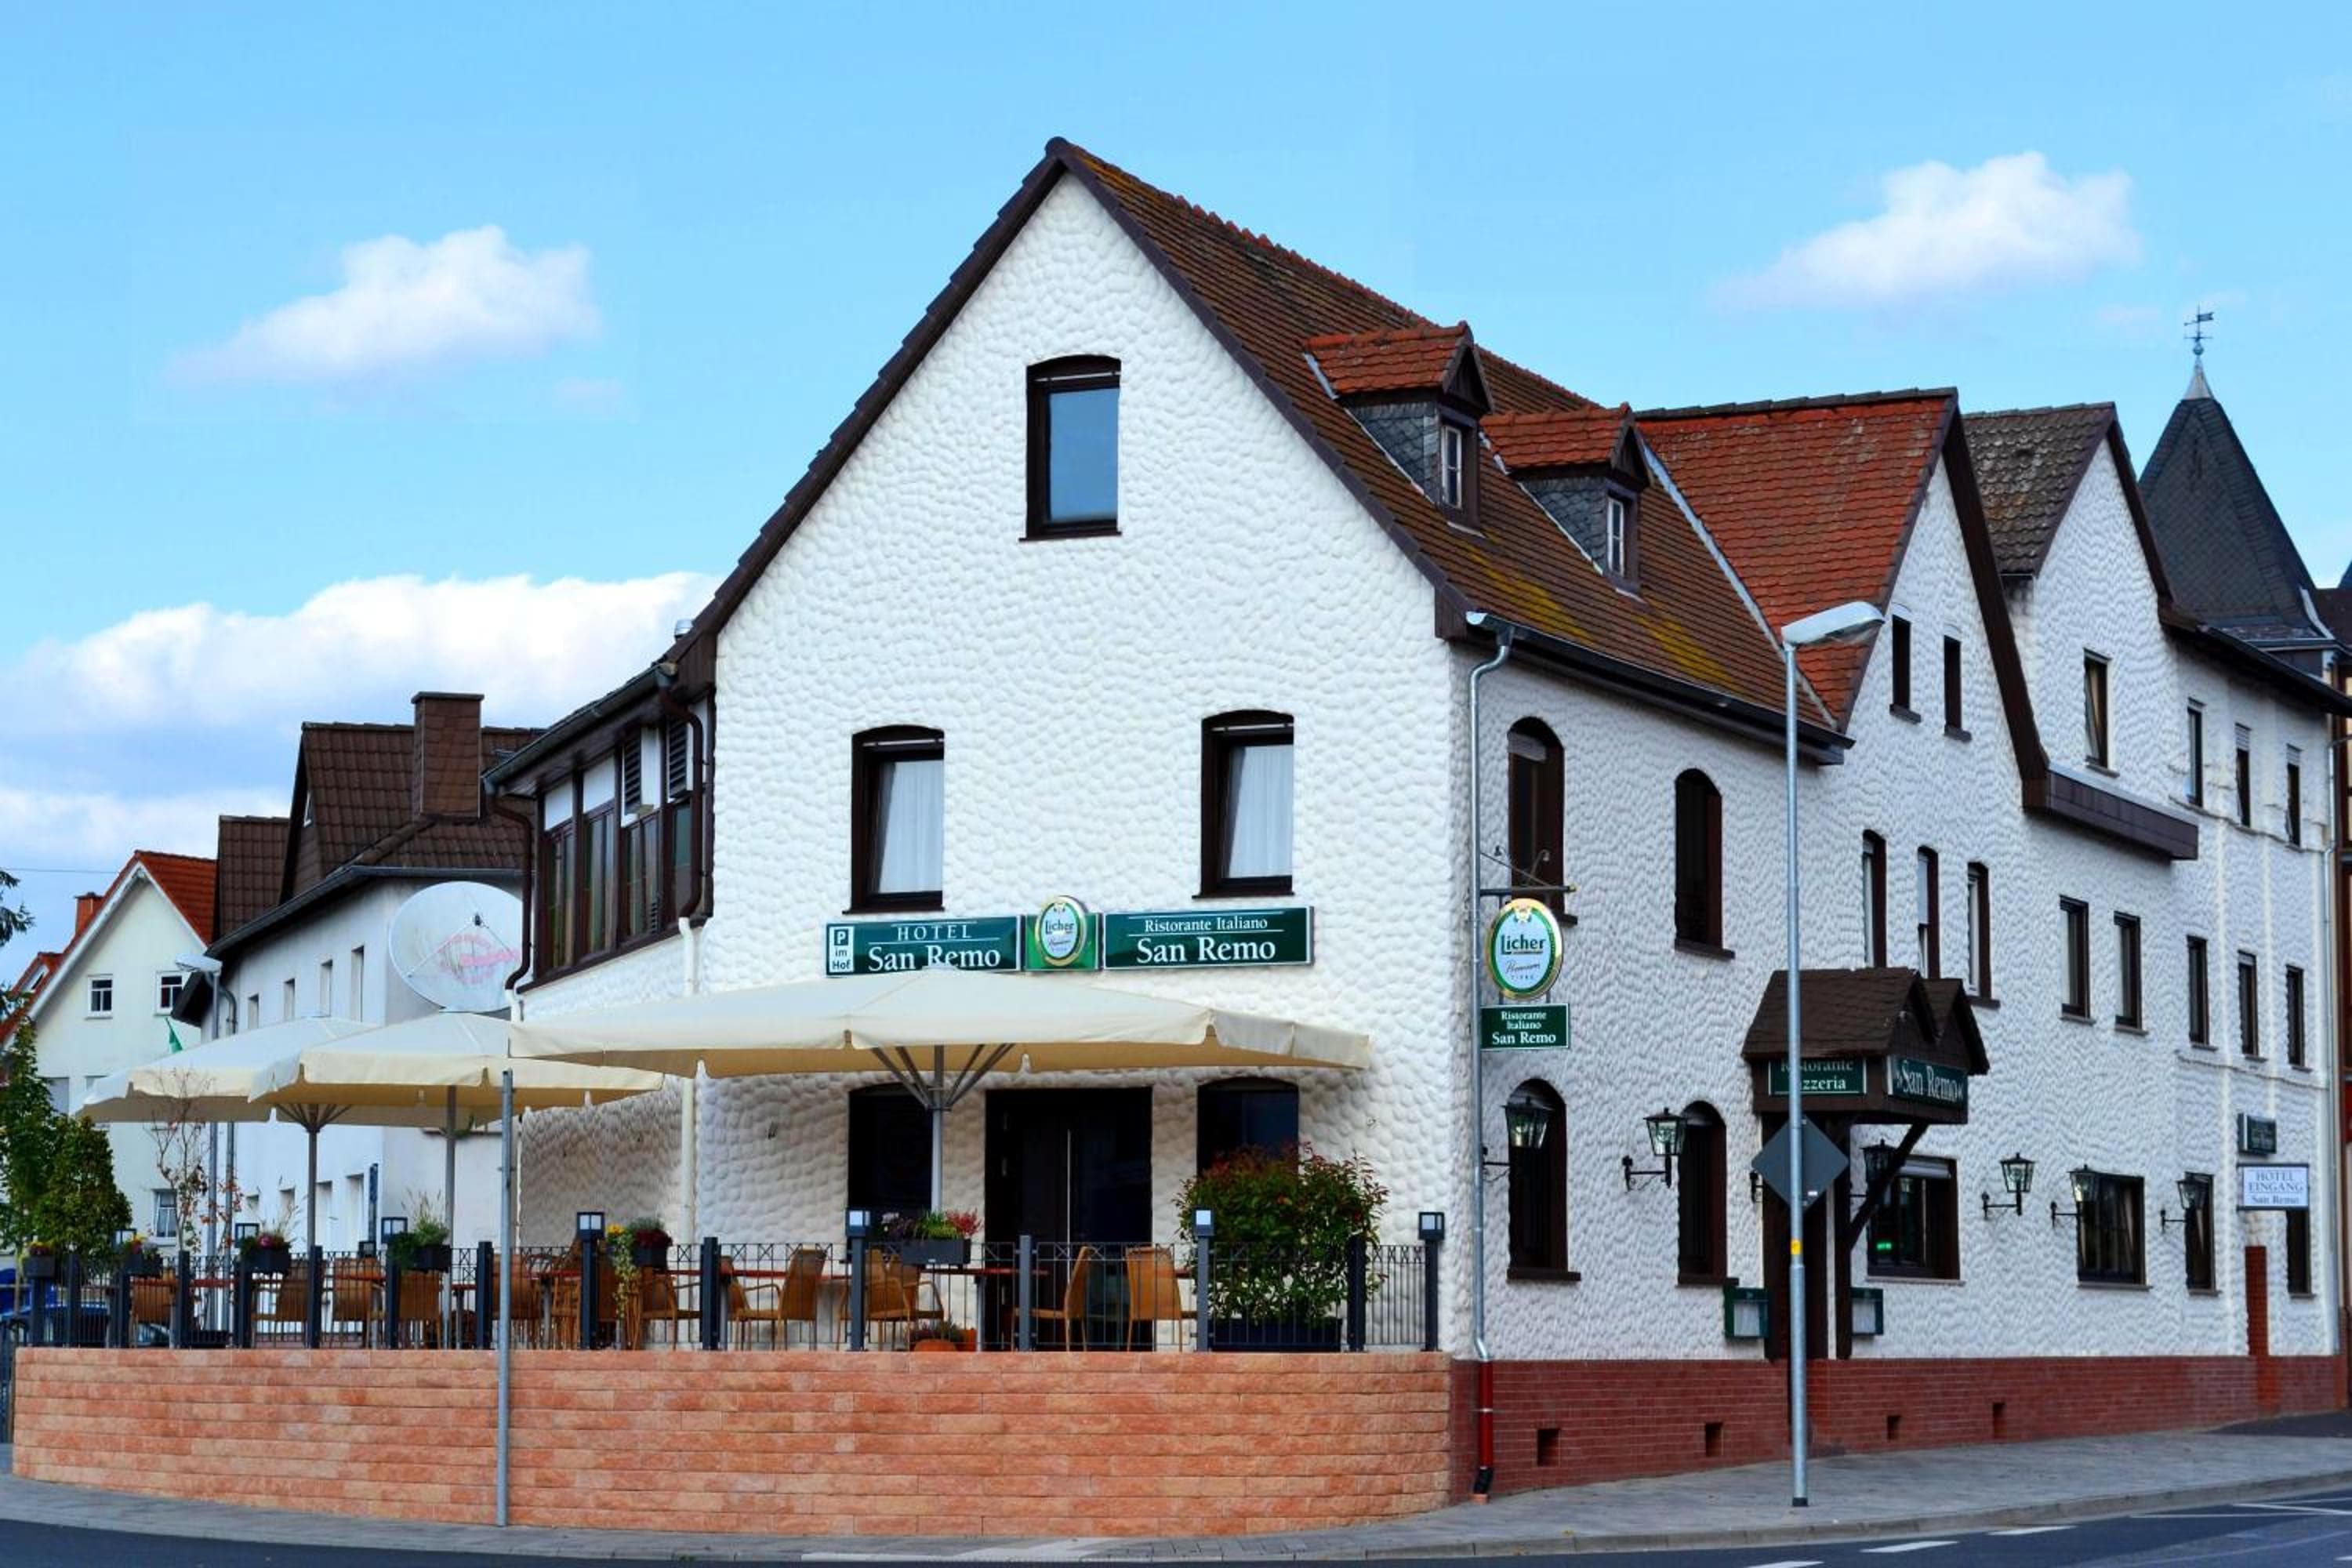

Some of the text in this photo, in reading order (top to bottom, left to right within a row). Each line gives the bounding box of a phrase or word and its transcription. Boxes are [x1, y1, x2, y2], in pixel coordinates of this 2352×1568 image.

[1045, 920, 1075, 935] Licher
[1145, 916, 1269, 933] Ristorante Italiano
[837, 931, 846, 943] P
[897, 924, 972, 941] HOTEL
[1137, 936, 1276, 964] San Remo
[1500, 934, 1547, 955] Licher
[833, 959, 851, 970] Hof
[868, 945, 1001, 971] San Remo
[1501, 1011, 1547, 1020] Ristorante
[1506, 1021, 1542, 1030] Italiano
[1492, 1031, 1556, 1045] San Remo
[1795, 1075, 1846, 1090] zzeria
[2256, 1172, 2295, 1181] HOTEL
[2248, 1182, 2304, 1192] EINGANG
